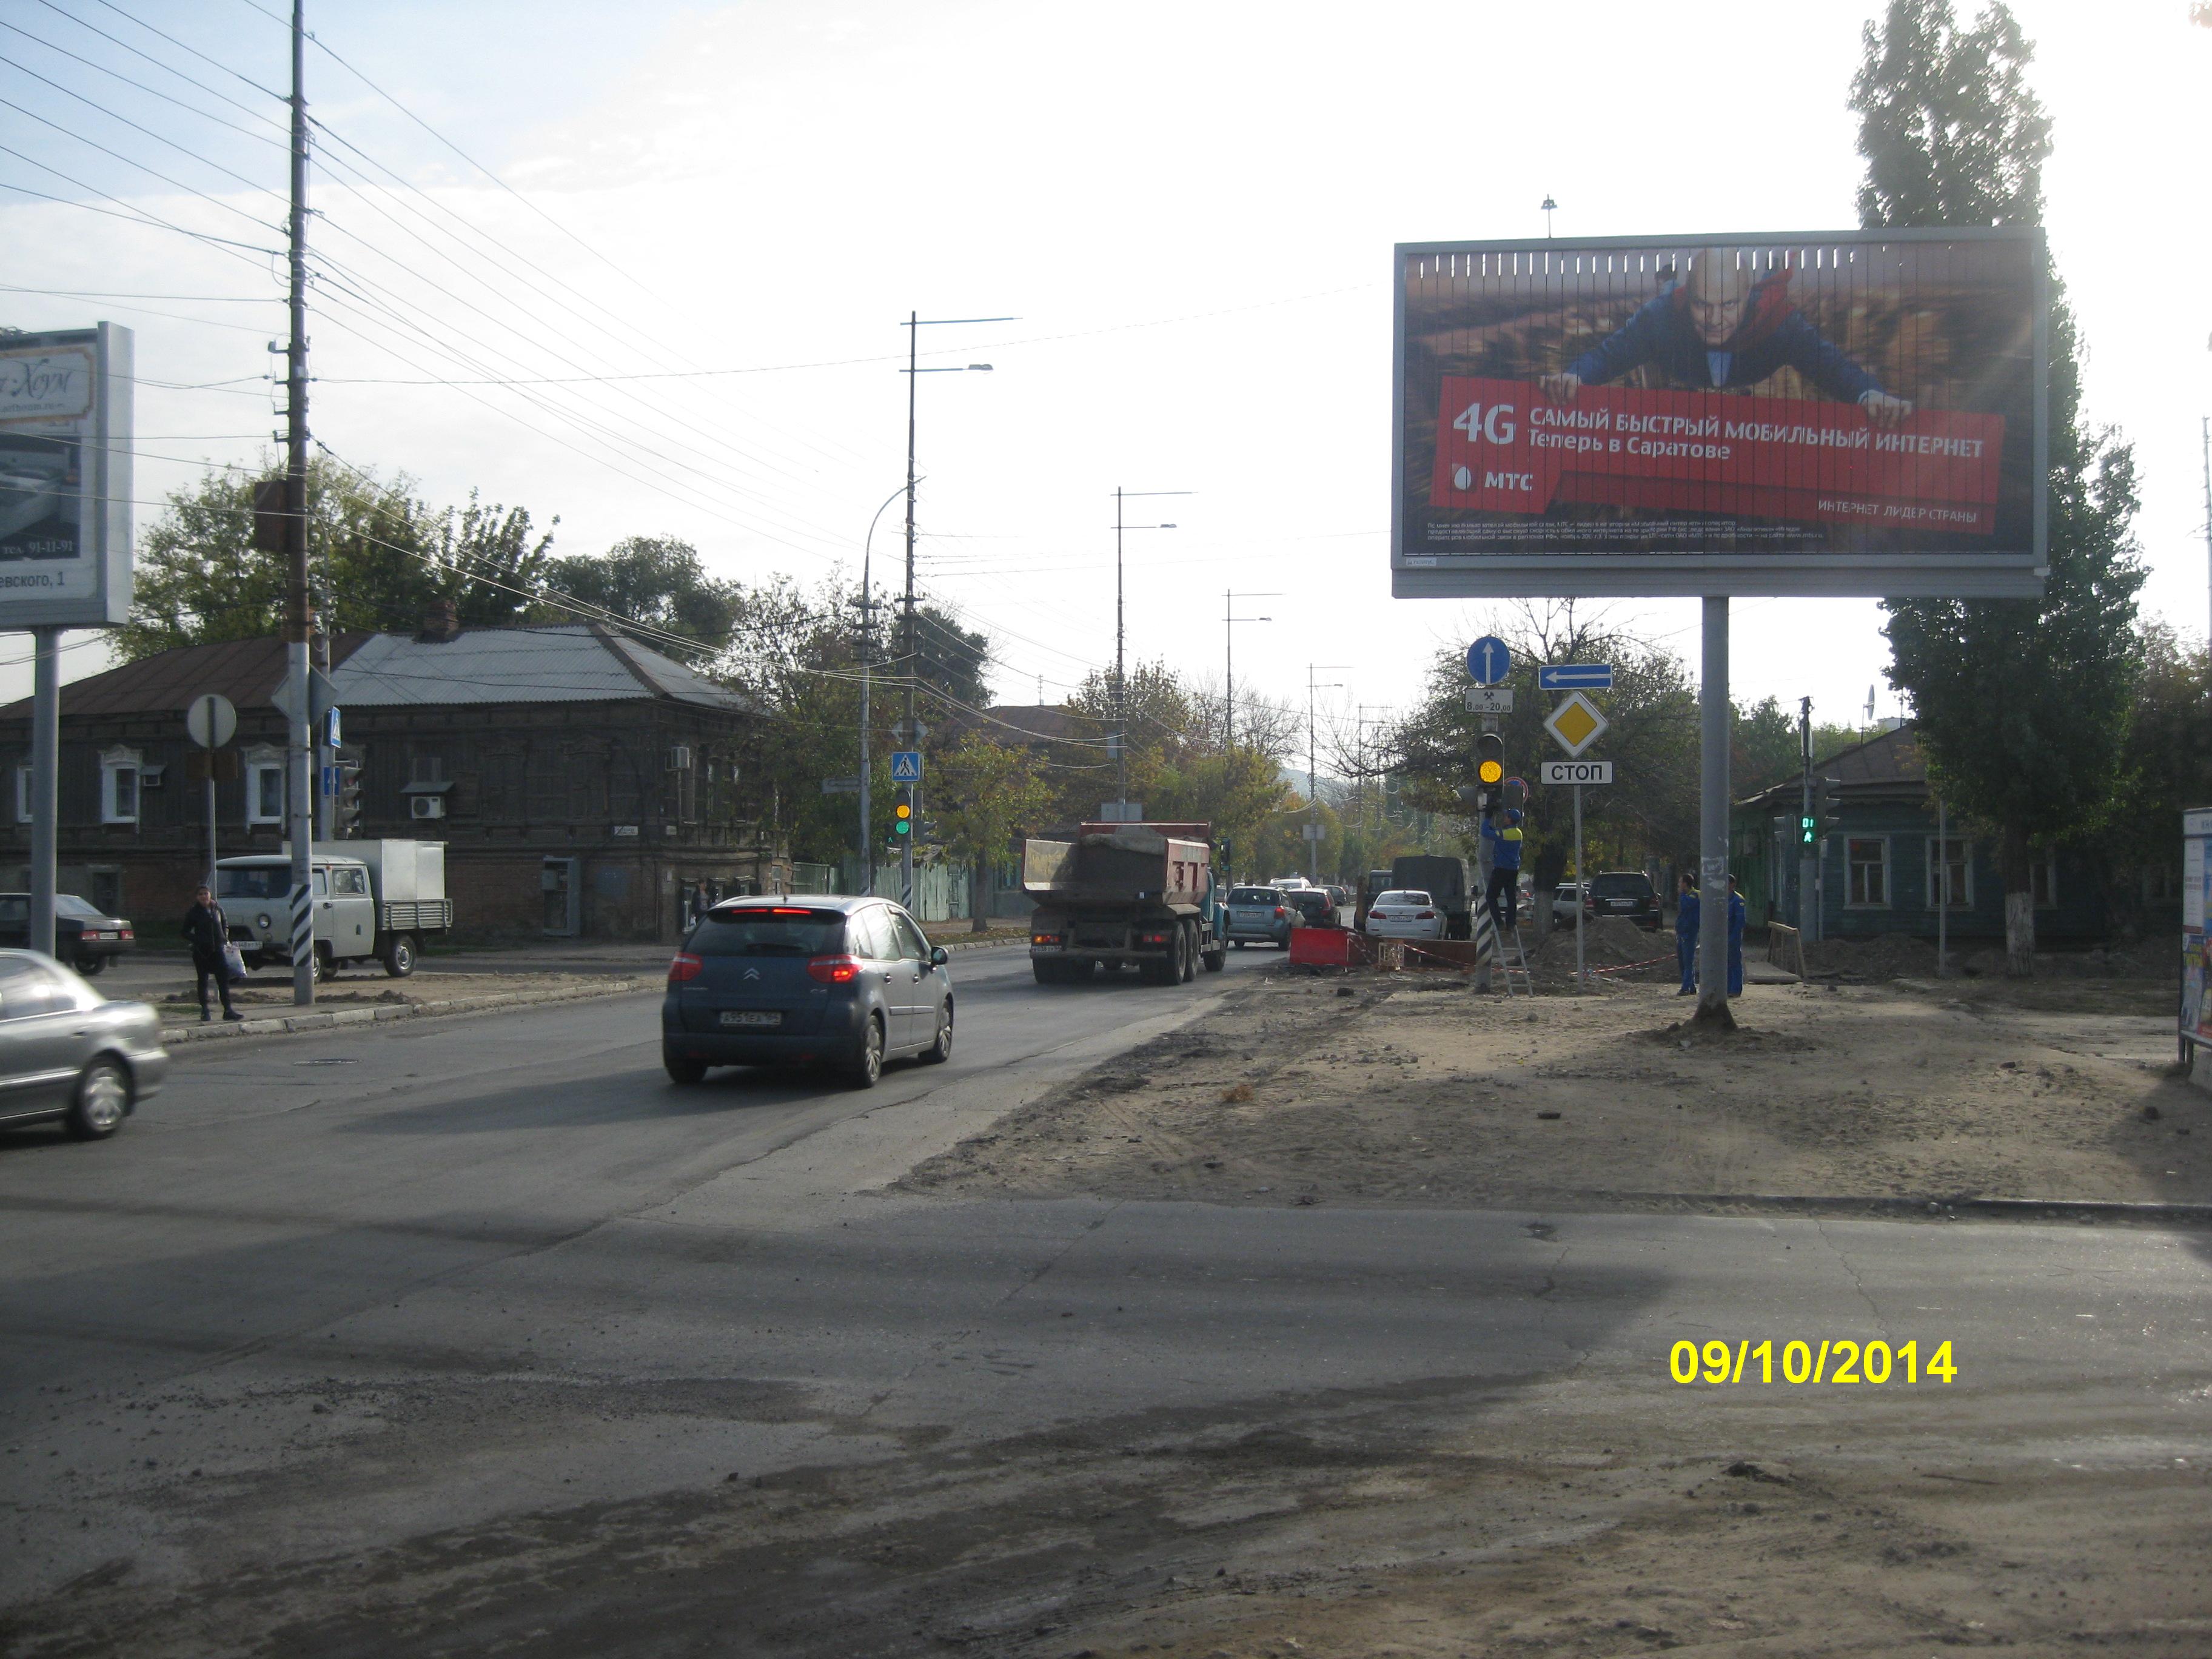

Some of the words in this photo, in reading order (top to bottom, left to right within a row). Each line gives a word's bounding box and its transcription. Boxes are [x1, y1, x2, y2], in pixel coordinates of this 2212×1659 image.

[1453, 402, 1515, 445] 4G
[1530, 407, 1610, 430] САМЫЙ
[1616, 414, 1719, 438] БЫСТРЫЙ
[1725, 421, 1869, 449] МОБИЛЬНЫЙ
[1875, 433, 1984, 458] ИНТЕРНЕТ
[1527, 428, 1603, 453] Теперь
[1609, 438, 1621, 452] в
[1627, 436, 1731, 460] Саратове
[1484, 471, 1533, 491] МТС
[1818, 499, 1879, 515] ИНТЕРНЕТ
[1883, 505, 1926, 520] ЛИДЕР
[1929, 508, 1977, 523] СТРАНЫ
[58, 571, 65, 586] 1
[1550, 765, 1603, 781] СТОП
